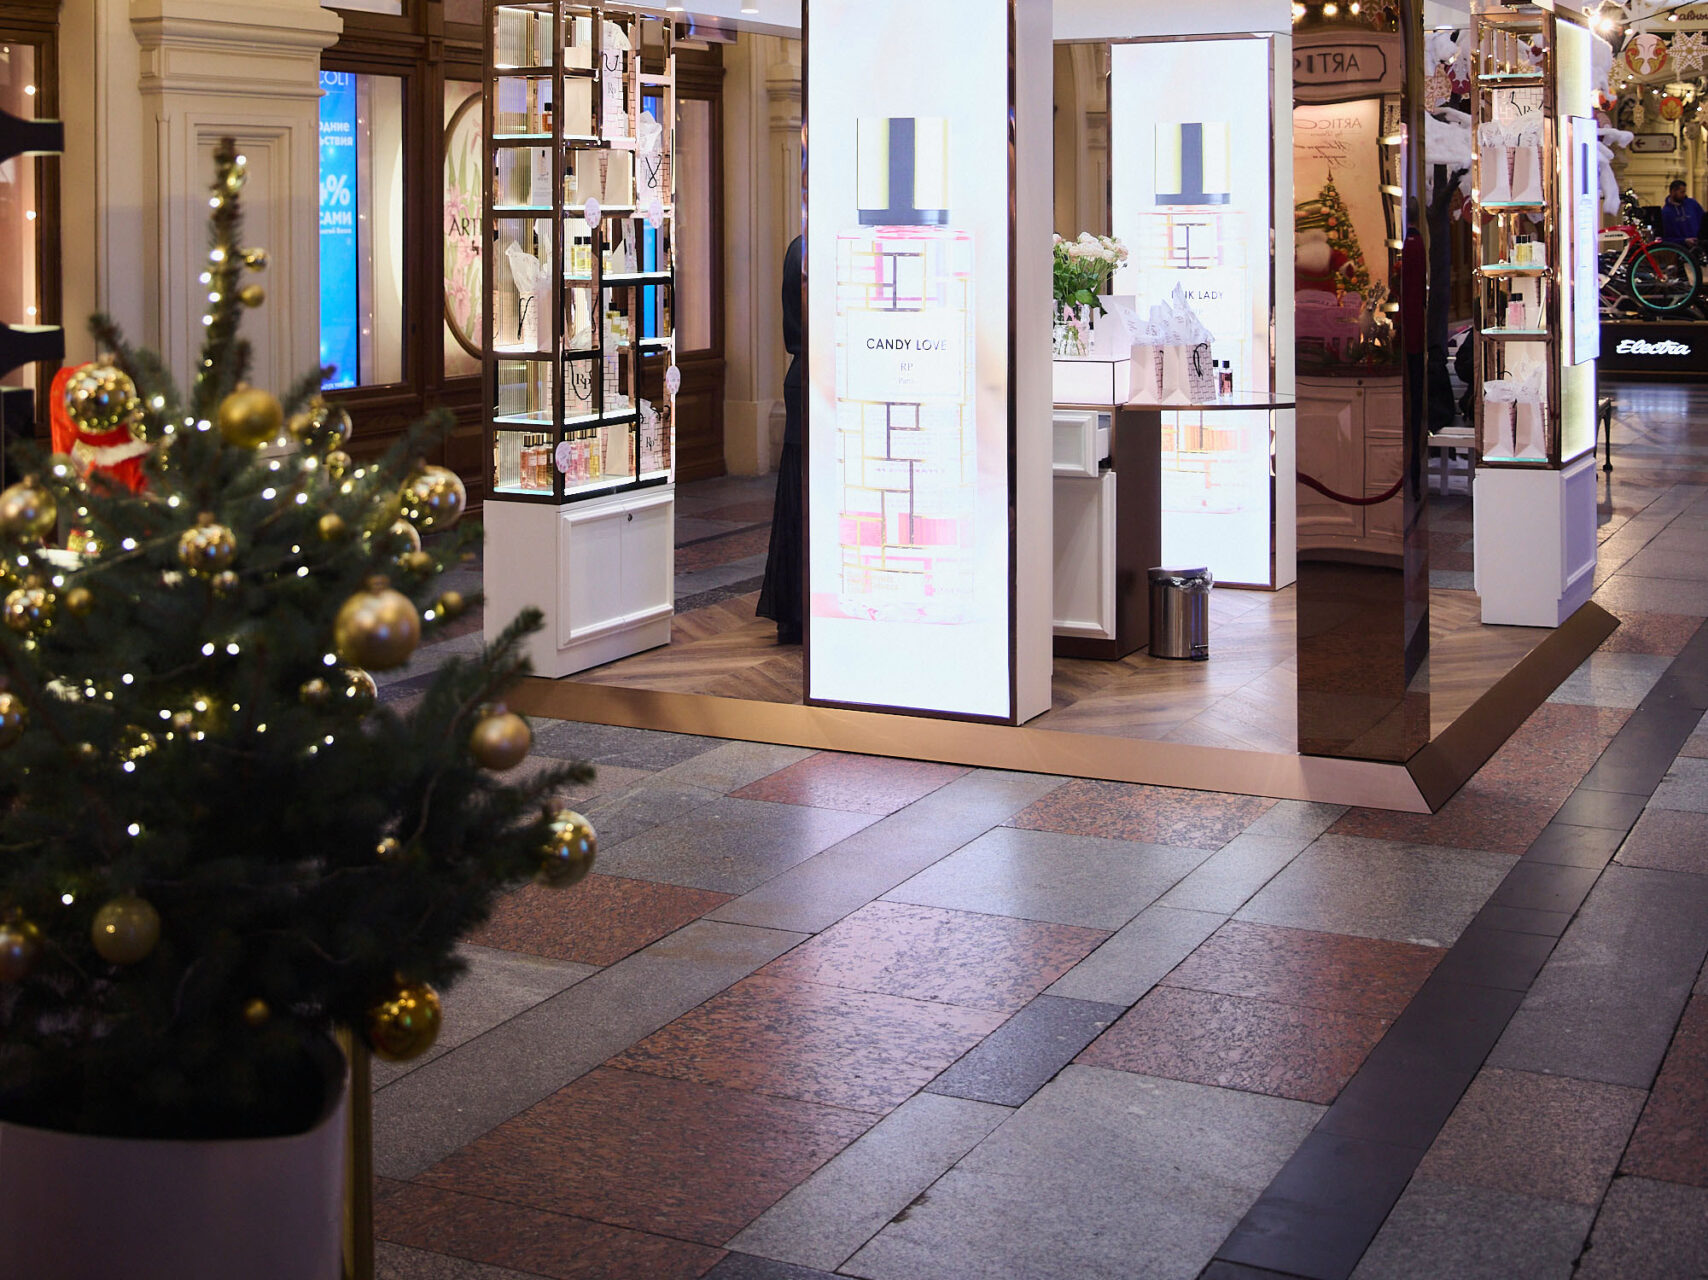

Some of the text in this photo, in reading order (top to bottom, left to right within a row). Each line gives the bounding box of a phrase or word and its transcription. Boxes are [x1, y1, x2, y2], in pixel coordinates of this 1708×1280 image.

[1198, 290, 1223, 300] LADY
[866, 338, 947, 351] CANDY LOVE
[1616, 339, 1691, 355] Electra
